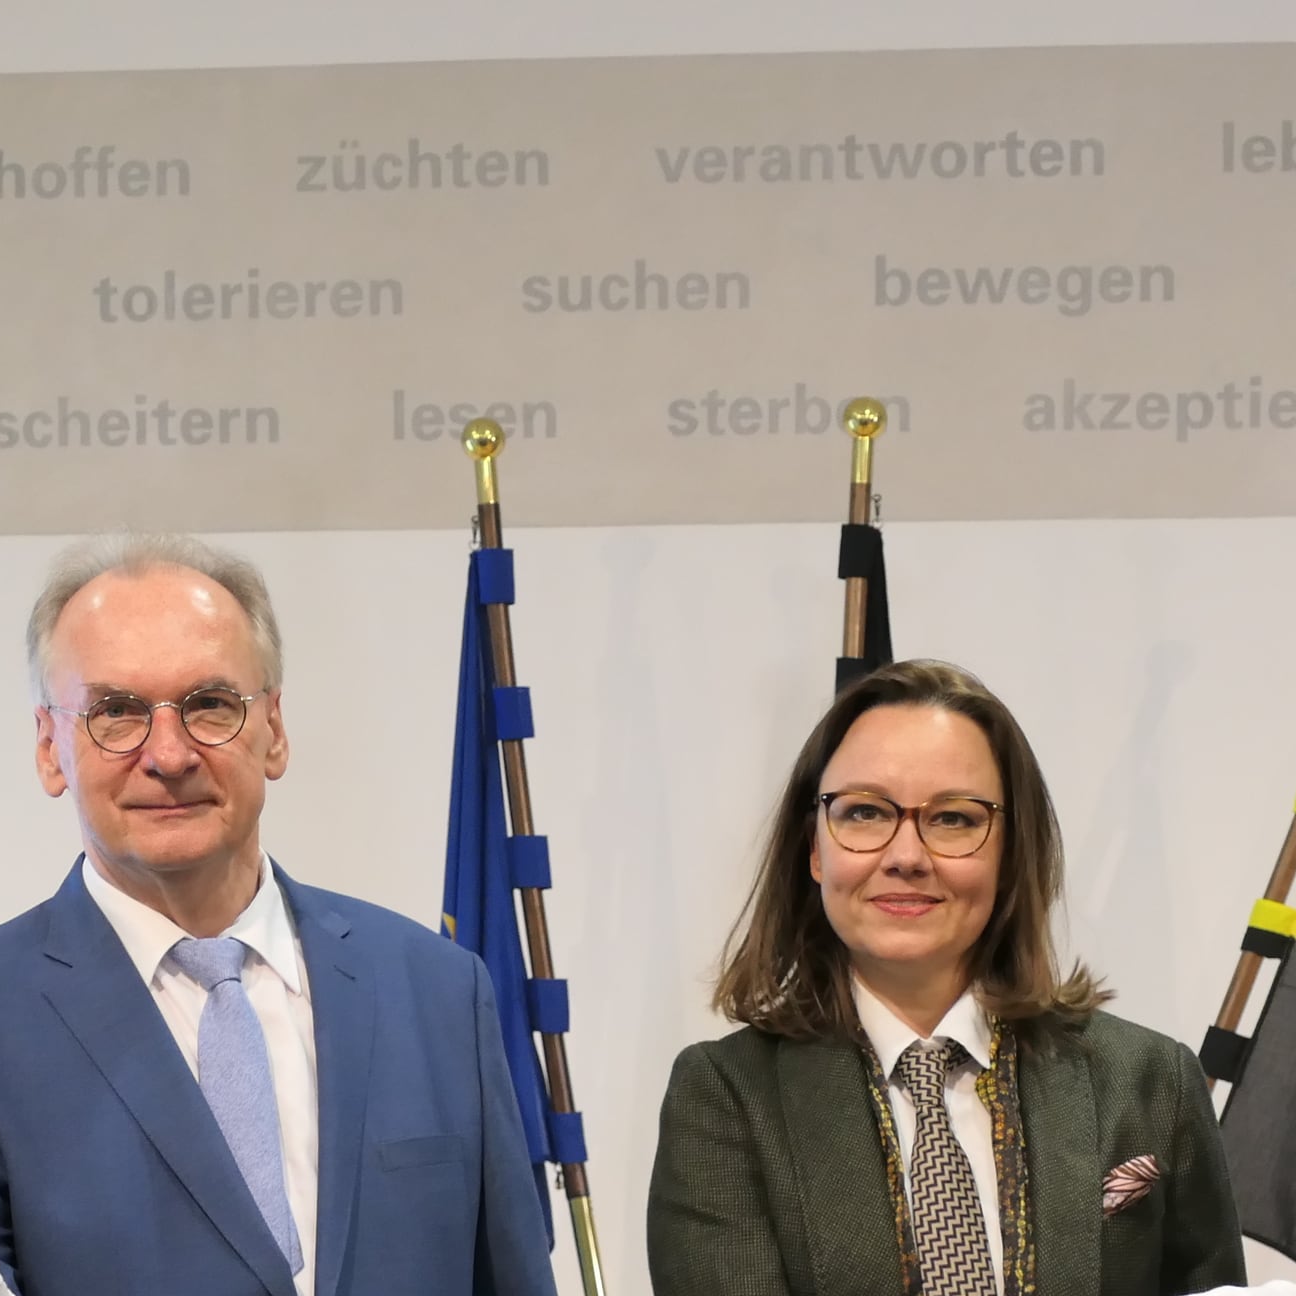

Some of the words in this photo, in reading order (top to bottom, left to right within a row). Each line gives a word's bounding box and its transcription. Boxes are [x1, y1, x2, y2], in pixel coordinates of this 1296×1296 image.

[296, 138, 549, 192] züchten
[655, 131, 1105, 184] verantworten
[92, 268, 403, 323] tolerieren
[522, 259, 750, 314] suchen
[875, 254, 1175, 318] bewegen
[667, 382, 911, 436] sterbn
